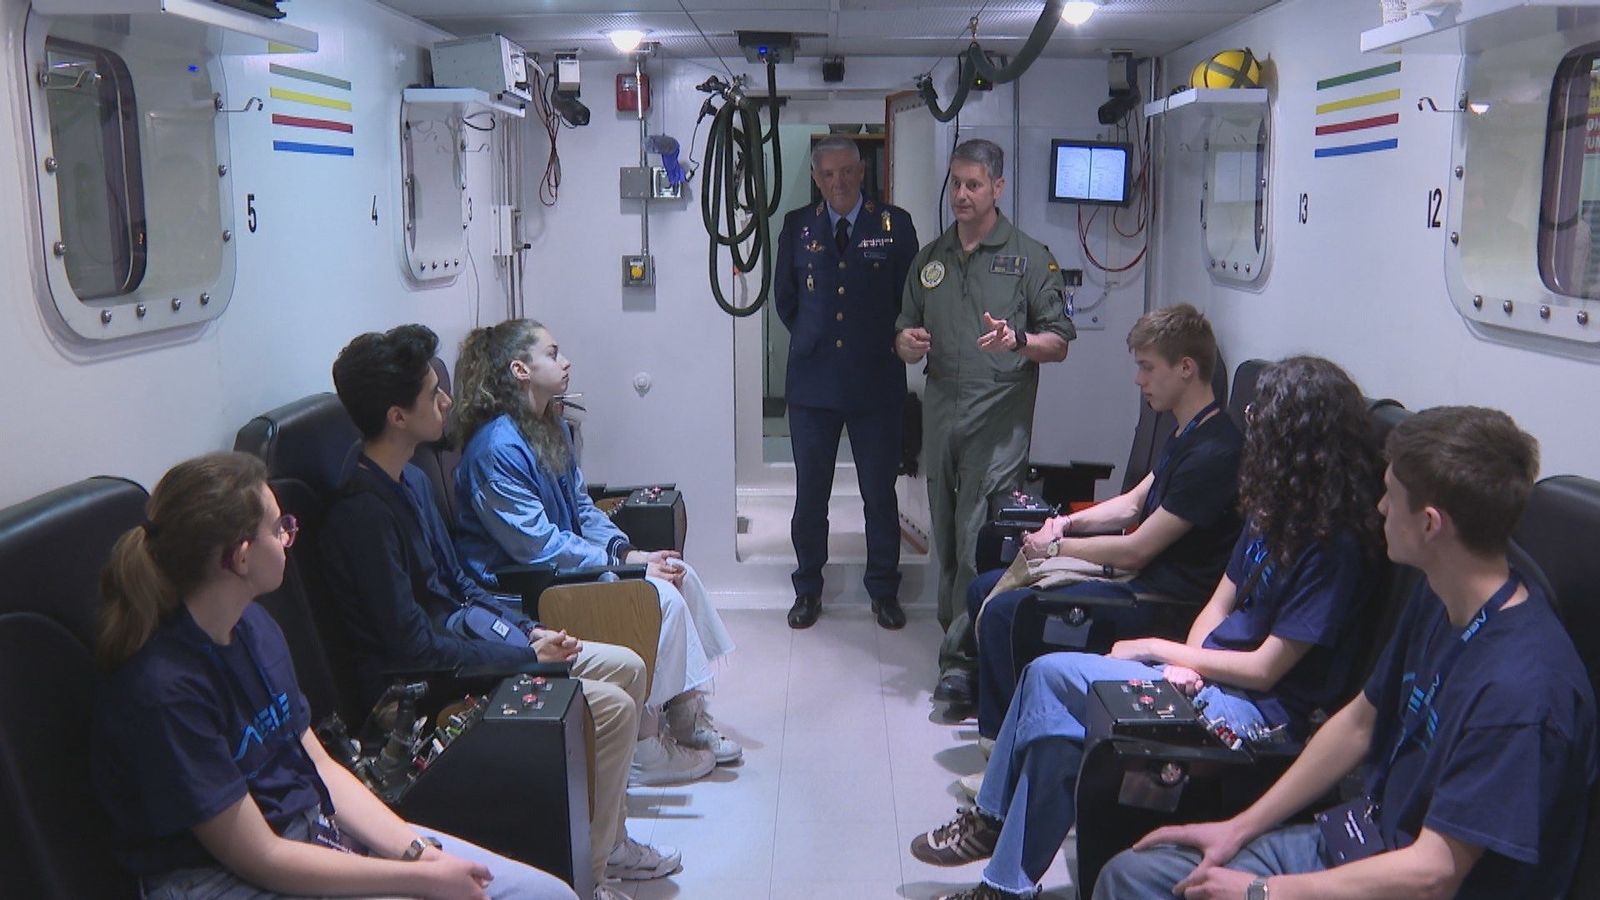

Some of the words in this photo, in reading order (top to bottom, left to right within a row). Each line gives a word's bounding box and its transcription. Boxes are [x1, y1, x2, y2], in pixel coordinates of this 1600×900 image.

[247, 193, 257, 233] 5
[371, 194, 378, 226] 4
[467, 197, 473, 222] 3
[1298, 193, 1309, 225] 13
[1427, 188, 1443, 229] 12
